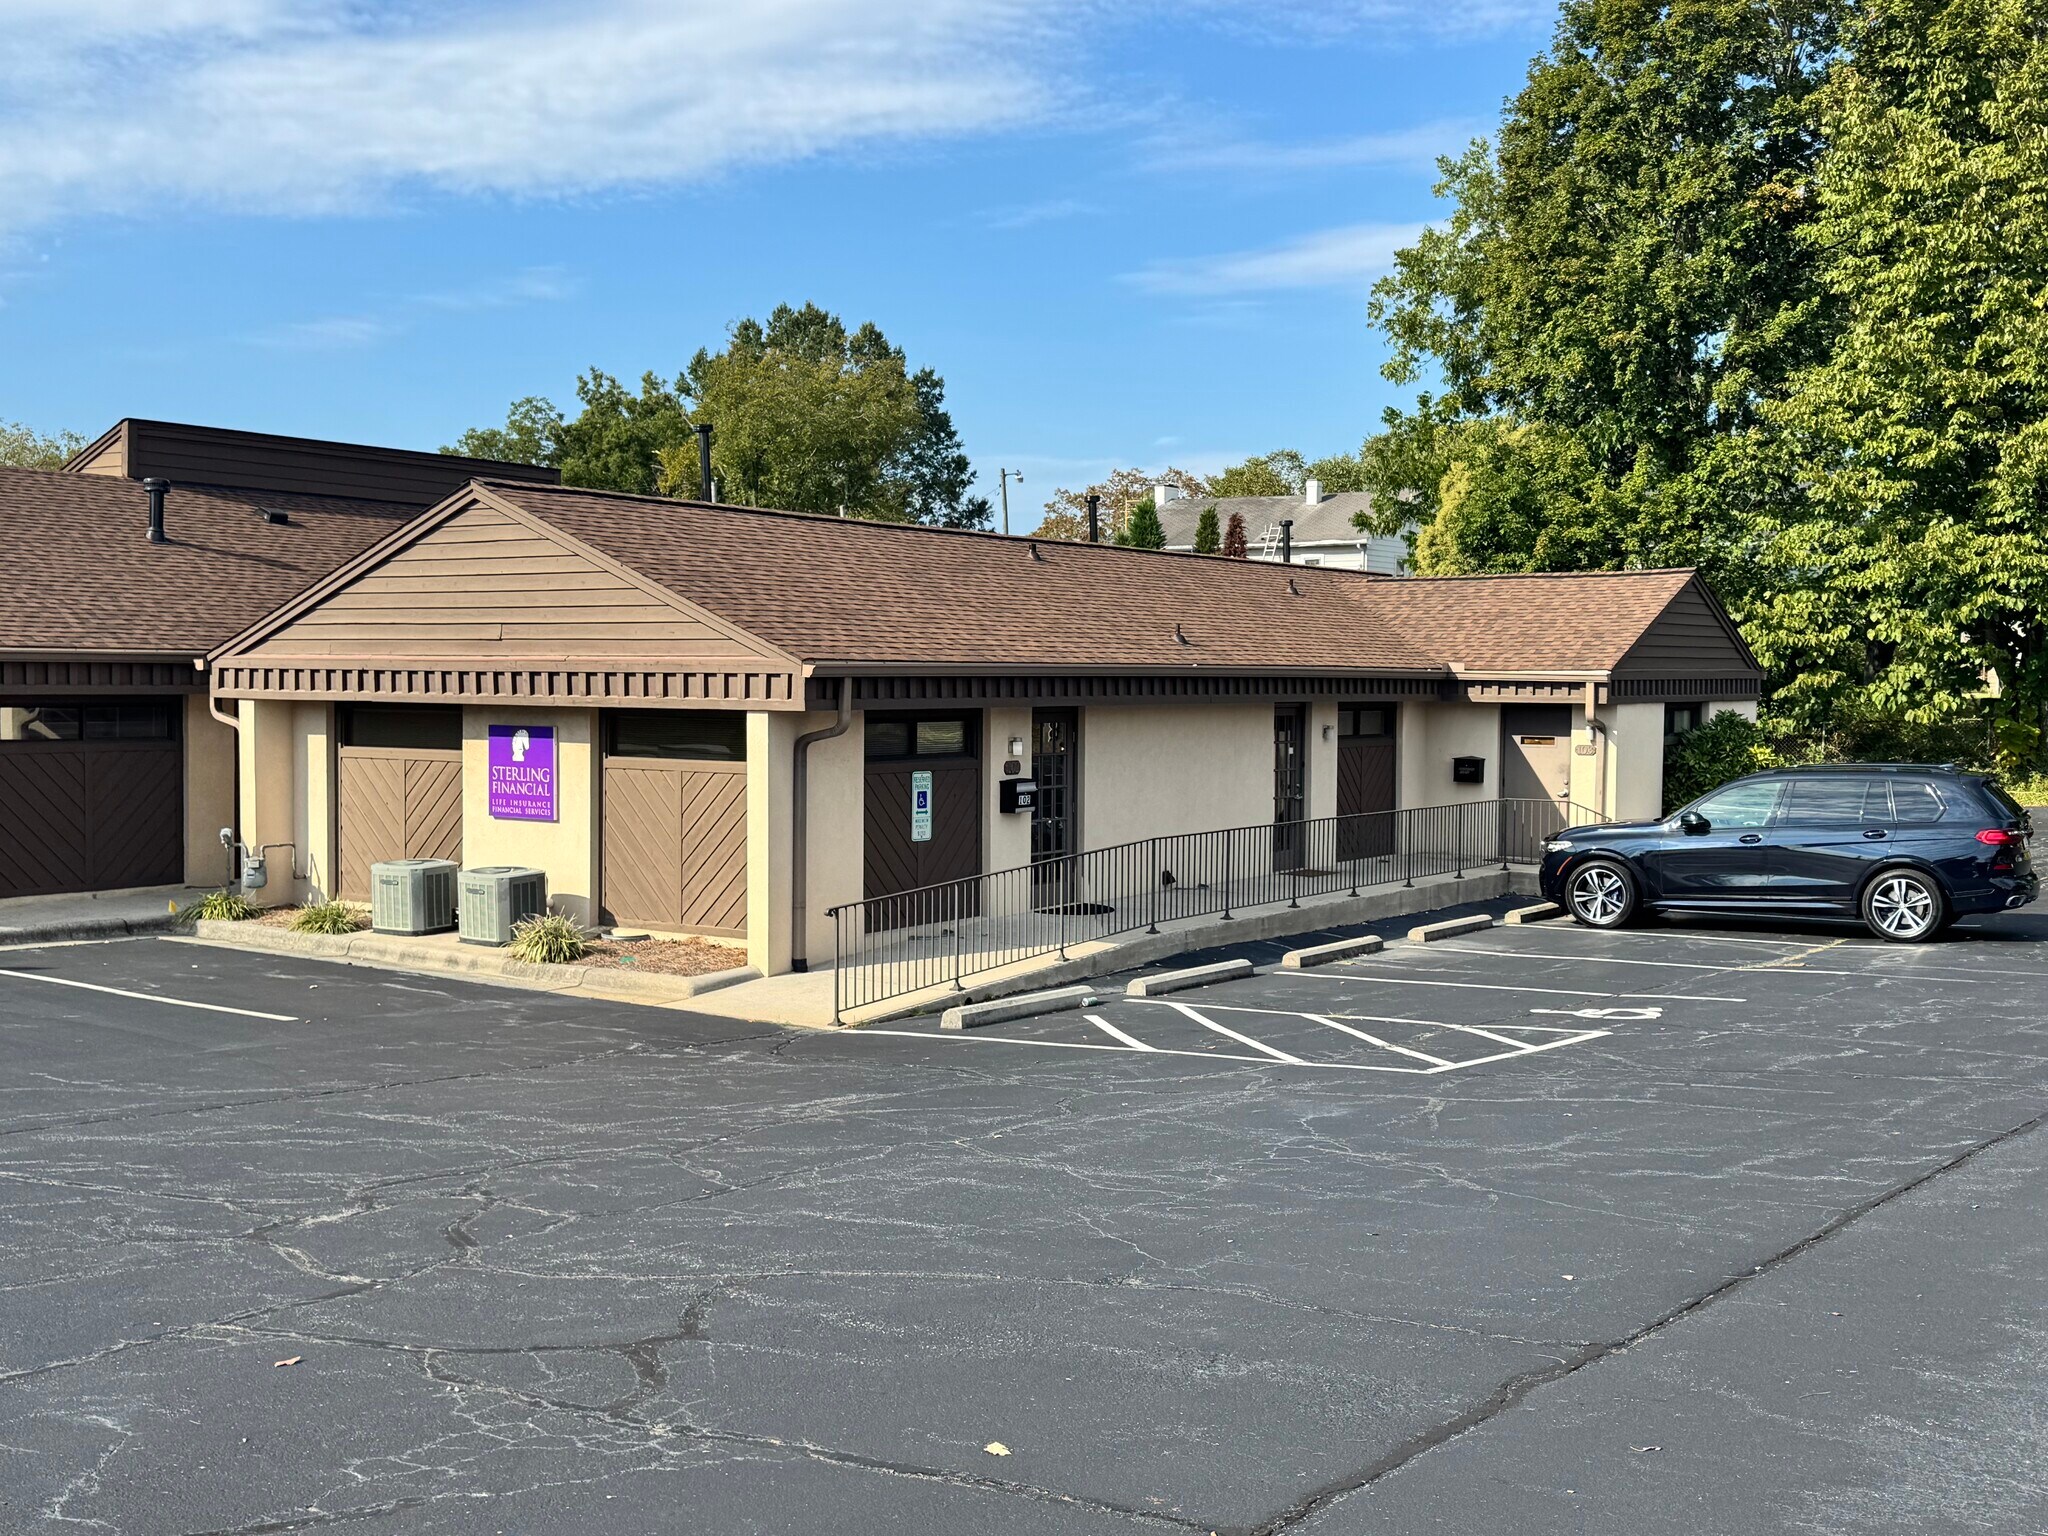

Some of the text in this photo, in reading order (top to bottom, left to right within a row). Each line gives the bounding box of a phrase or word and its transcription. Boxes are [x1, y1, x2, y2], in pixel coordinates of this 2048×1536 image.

[492, 766, 550, 782] STERLING
[492, 781, 550, 796] FINANCIAL
[492, 805, 551, 816] FINANCIAL SERVICES
[510, 800, 550, 808] INSURANCE
